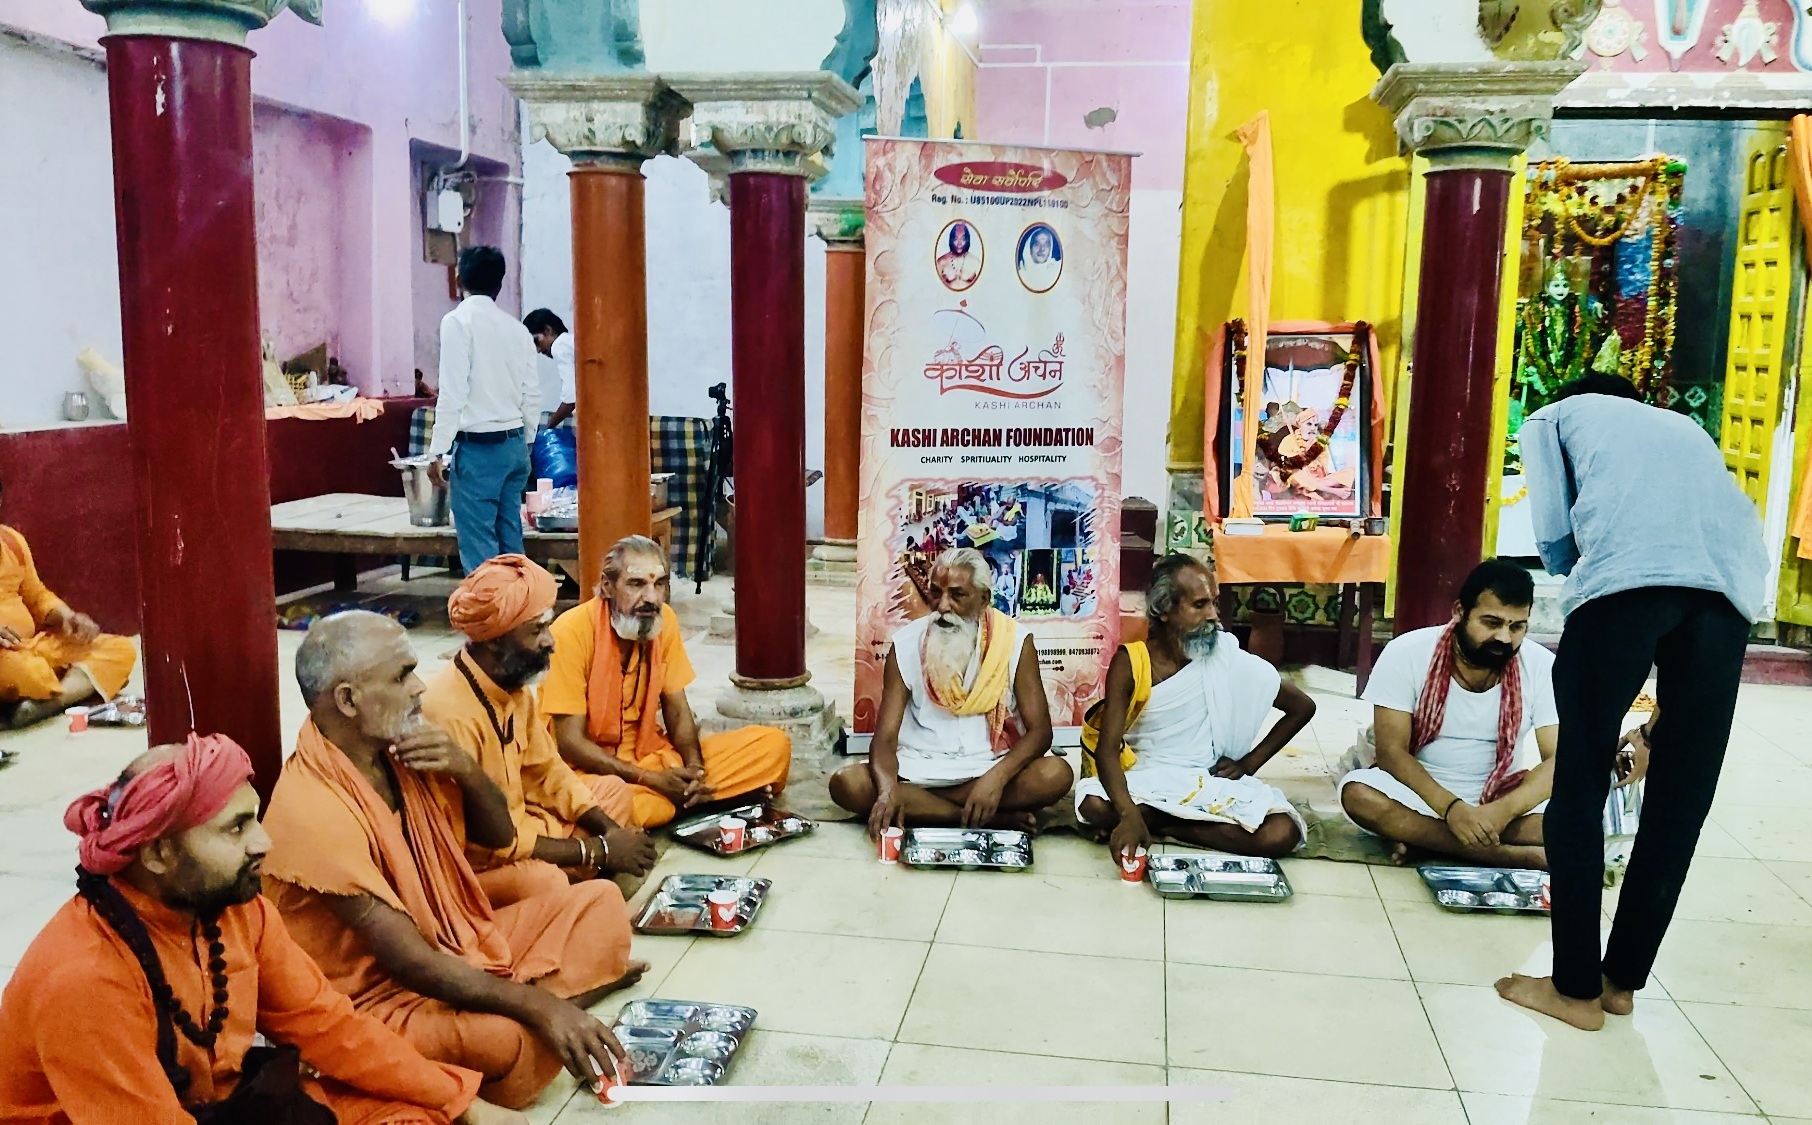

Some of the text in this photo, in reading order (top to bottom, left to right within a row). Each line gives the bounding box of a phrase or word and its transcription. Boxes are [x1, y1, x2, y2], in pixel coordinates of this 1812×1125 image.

[960, 167, 987, 186] सेवा
[924, 345, 1065, 384] काशी अर्चन
[974, 401, 1062, 410] KASHI ARCHAN
[890, 427, 1094, 448] KASHI ARCHAN FOUNDATION
[920, 455, 1067, 464] CHARITY SPRITIUALITY HOSPITALITY
